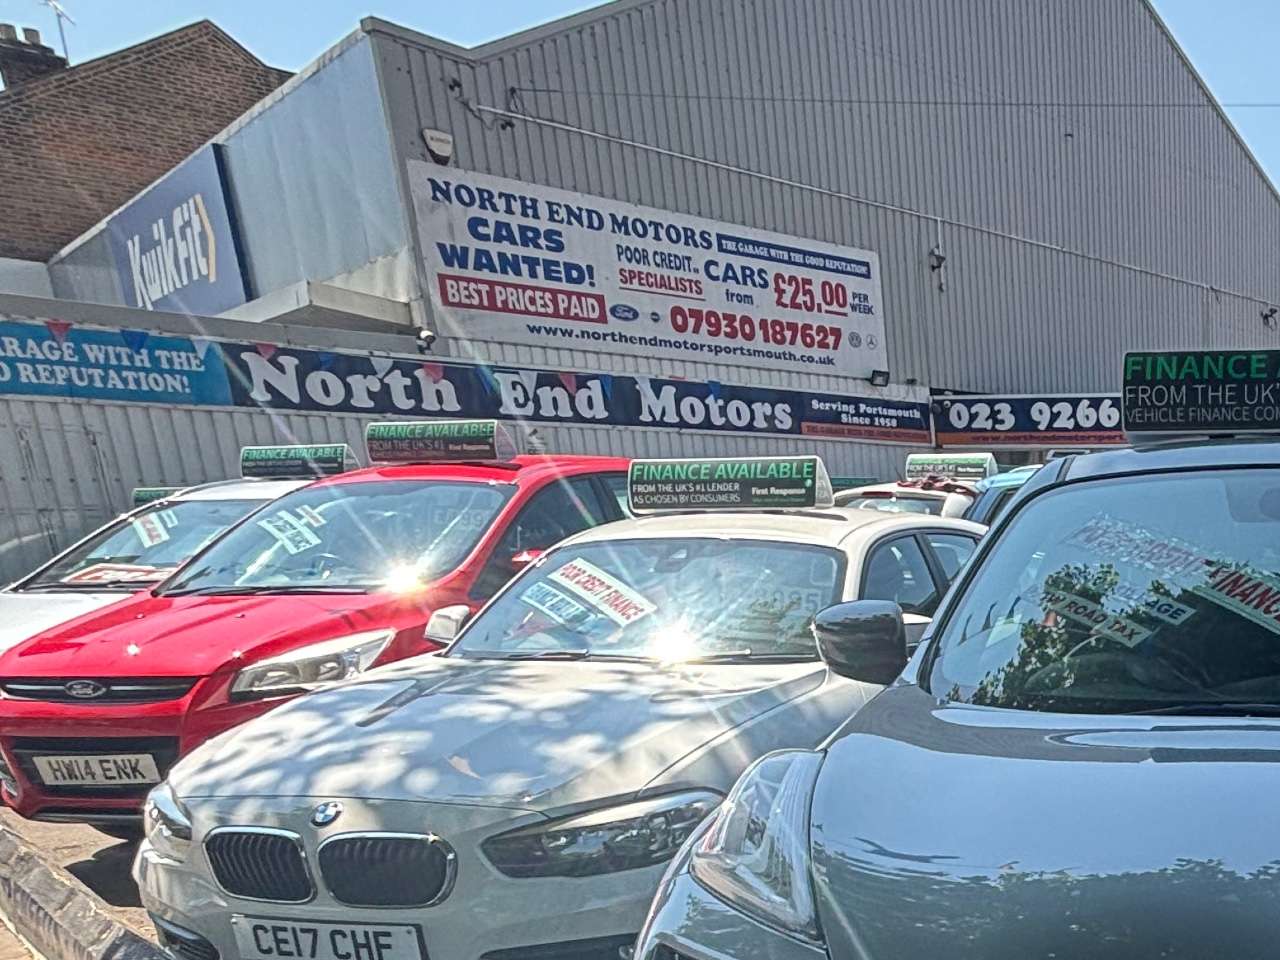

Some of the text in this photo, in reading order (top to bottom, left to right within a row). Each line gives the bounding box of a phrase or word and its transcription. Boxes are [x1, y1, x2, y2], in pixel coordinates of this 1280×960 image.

[427, 178, 713, 250] NORTH END MOTORS
[467, 216, 565, 252] CARS
[436, 242, 596, 287] WANTED!
[616, 244, 650, 266] POOR
[721, 239, 737, 250] THE
[738, 242, 769, 258] GARAGE
[770, 247, 789, 261] WITH
[790, 251, 805, 263] THE
[805, 254, 825, 267] GOOD
[619, 268, 703, 296] SPECIALISTS
[704, 259, 769, 289] CARS
[446, 279, 600, 319] BEST PRICES PAID
[725, 289, 754, 305] from
[773, 272, 848, 314] £25.00
[852, 292, 869, 304] PER
[850, 302, 874, 316] WEEK
[670, 305, 842, 350] 07930 187627
[83, 343, 151, 368] WITH
[155, 350, 206, 371] THE
[527, 323, 835, 366] www.northendmotorsportsmouth.co.uk
[17, 362, 191, 394] REPUTATION!
[1126, 353, 1268, 381] FINANCE
[241, 352, 793, 430] North End Motors
[1125, 385, 1194, 407] FROM
[1197, 384, 1237, 405] THE
[811, 399, 921, 419] Serving Portsmouth
[841, 413, 871, 424] Since
[950, 399, 1120, 431] 023 9266
[1127, 406, 1185, 423] VEHICLE
[1188, 406, 1250, 422] FINANCE
[368, 423, 494, 438] FINANCE AVAILABLE
[244, 447, 343, 460] FINANCE AVAILABLE
[632, 462, 813, 481] FINANCE AVAILABLE
[633, 483, 655, 493] FROM
[657, 483, 673, 493] THE
[707, 482, 740, 492] LENDER
[752, 487, 768, 496] First
[1063, 600, 1142, 641] ROAD TAX
[98, 758, 146, 780] ENK
[253, 923, 319, 958] CE17
